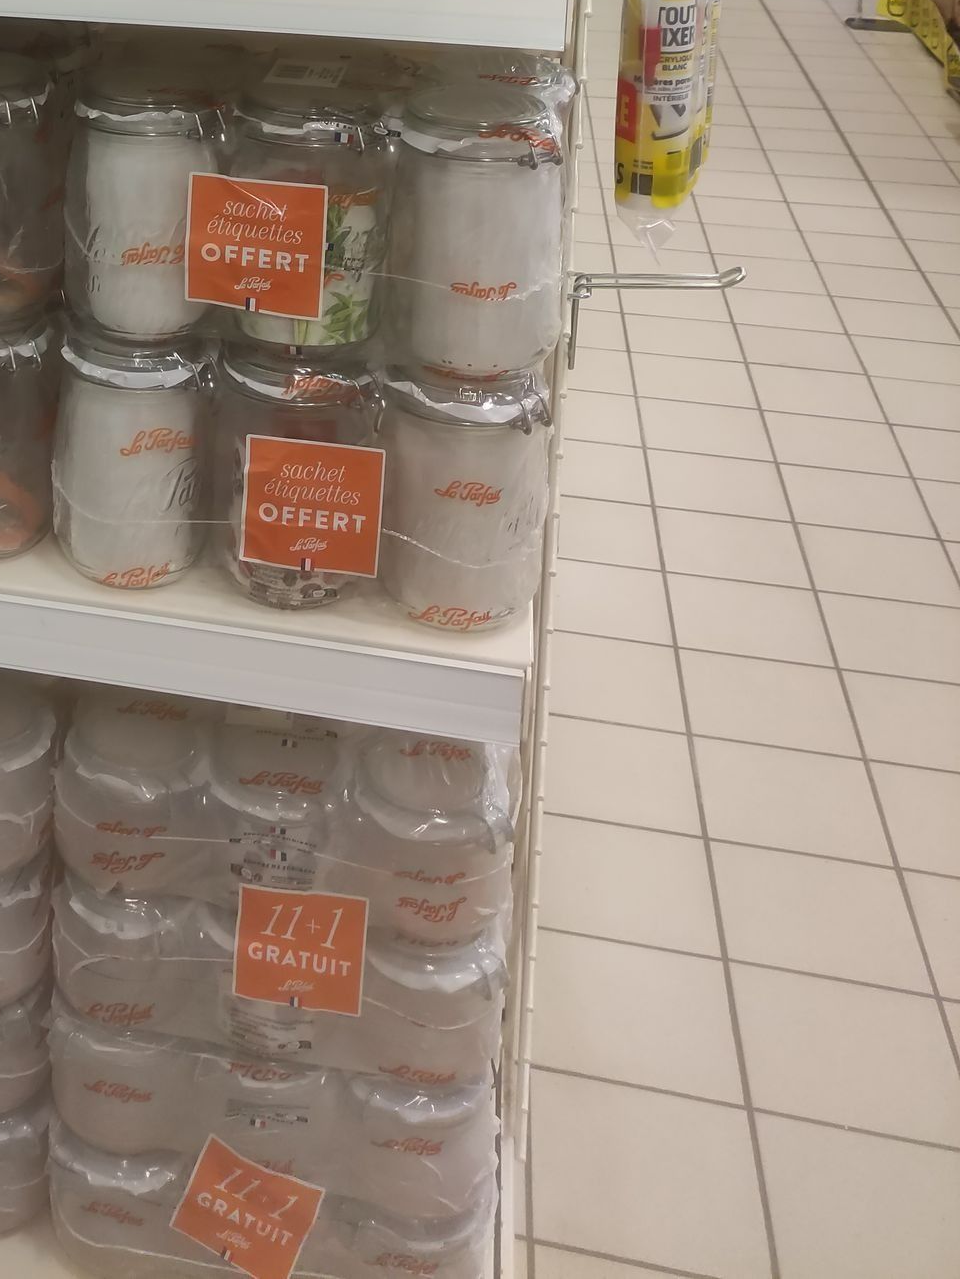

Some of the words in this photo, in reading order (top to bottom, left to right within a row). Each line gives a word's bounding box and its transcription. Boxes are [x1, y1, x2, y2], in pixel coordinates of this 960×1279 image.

[661, 26, 695, 47] IXER
[662, 63, 687, 72] BLANC
[223, 199, 288, 223] sachet
[207, 214, 303, 245] étiquettes
[200, 242, 310, 273] OFFERT
[234, 278, 248, 291] Le
[246, 276, 272, 292] Parfait
[280, 461, 346, 483] sachet
[264, 478, 361, 506] étiquettes
[434, 480, 461, 498] Le
[460, 482, 504, 507] Parfait
[258, 502, 367, 534] OFFERT
[289, 538, 304, 552] Le
[302, 537, 328, 552] Parfait
[408, 605, 440, 623] Le
[439, 607, 492, 630] Parfait
[260, 903, 344, 950] 11+1
[247, 941, 351, 977] GRATUIT
[196, 1192, 293, 1246] GRATUIT
